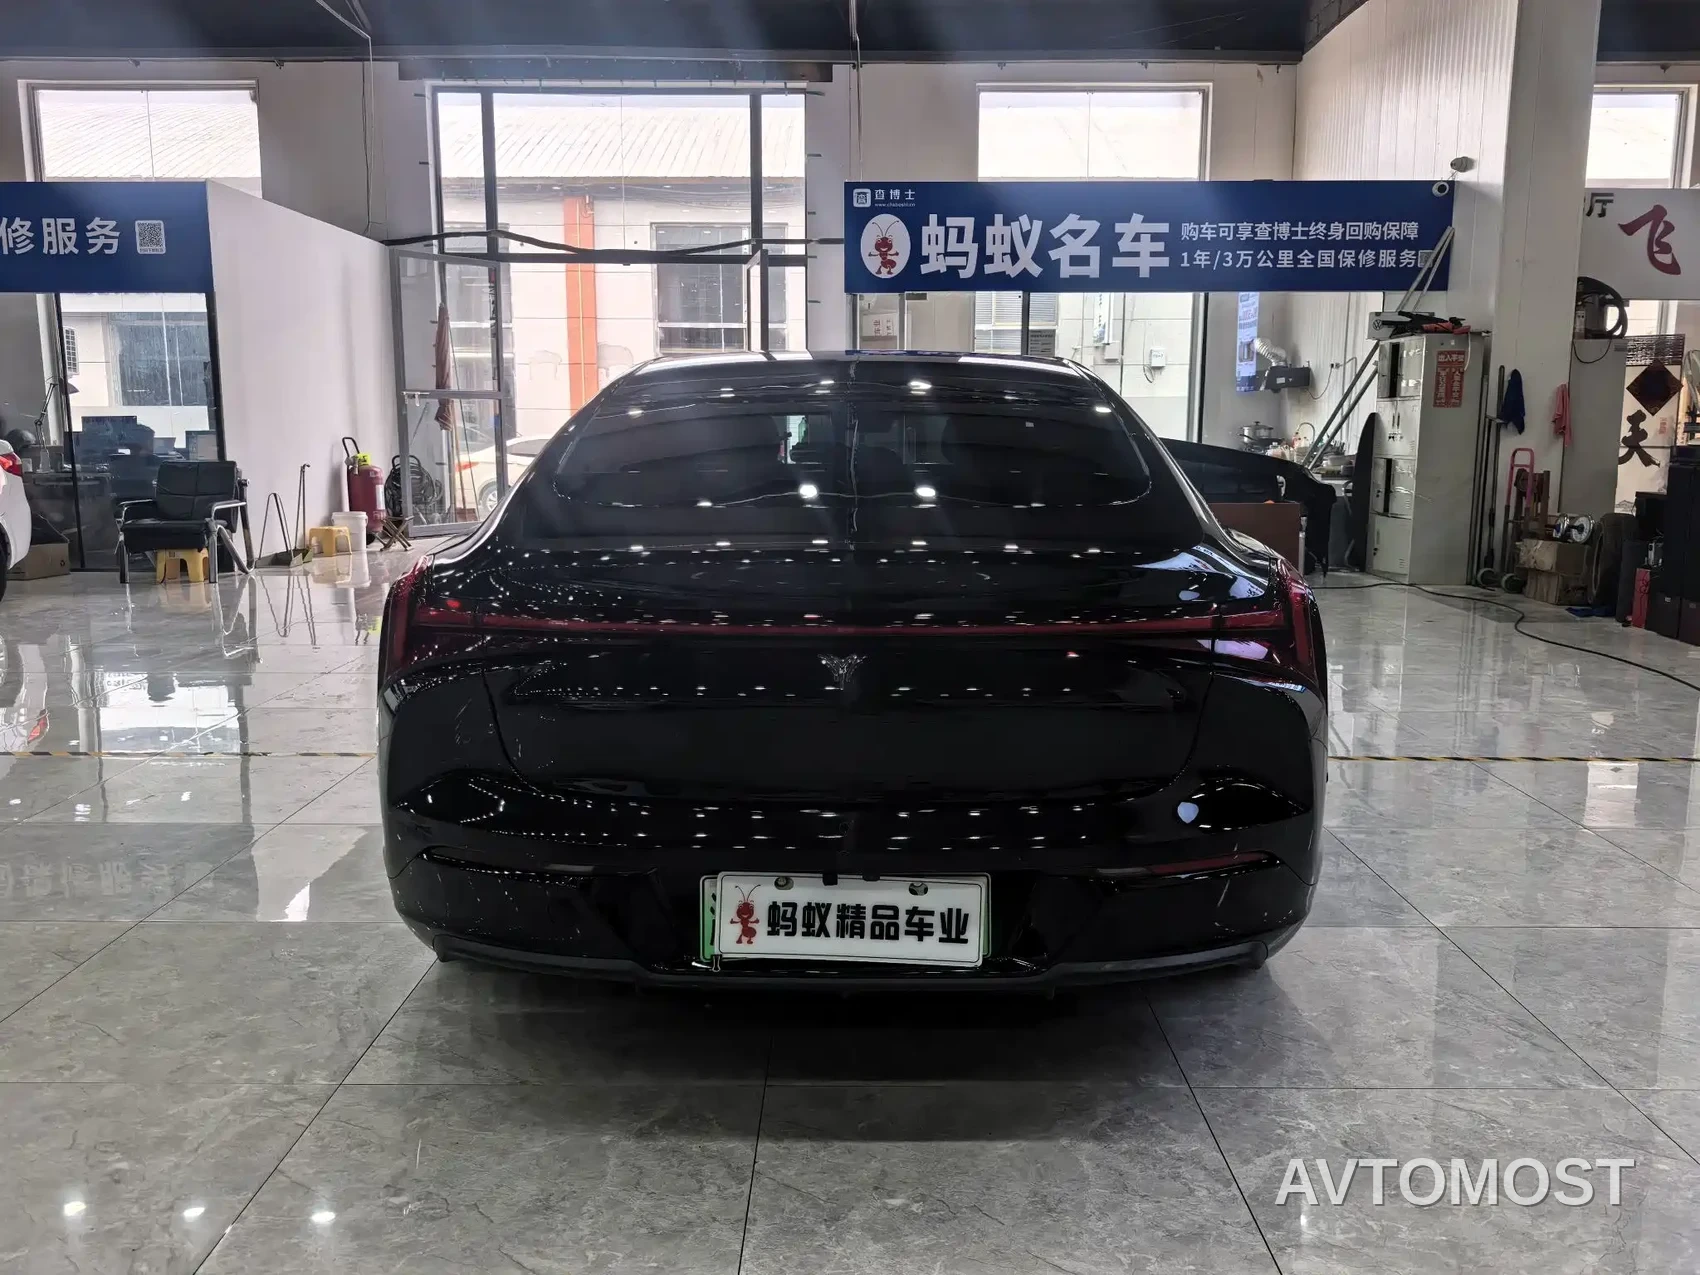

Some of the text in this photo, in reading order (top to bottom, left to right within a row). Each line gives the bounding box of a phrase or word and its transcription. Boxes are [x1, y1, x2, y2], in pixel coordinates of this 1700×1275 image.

[874, 189, 916, 200] 查博士
[0, 217, 121, 255] 修服务
[920, 213, 1170, 279] 蚂蚁名车
[1181, 222, 1419, 241] 购车可享查博士终身回购保障
[1617, 204, 1681, 276] 飞
[1180, 249, 1418, 270] 1年/3万公里全国保修服务
[767, 901, 970, 944] 蚂蚁精品车业
